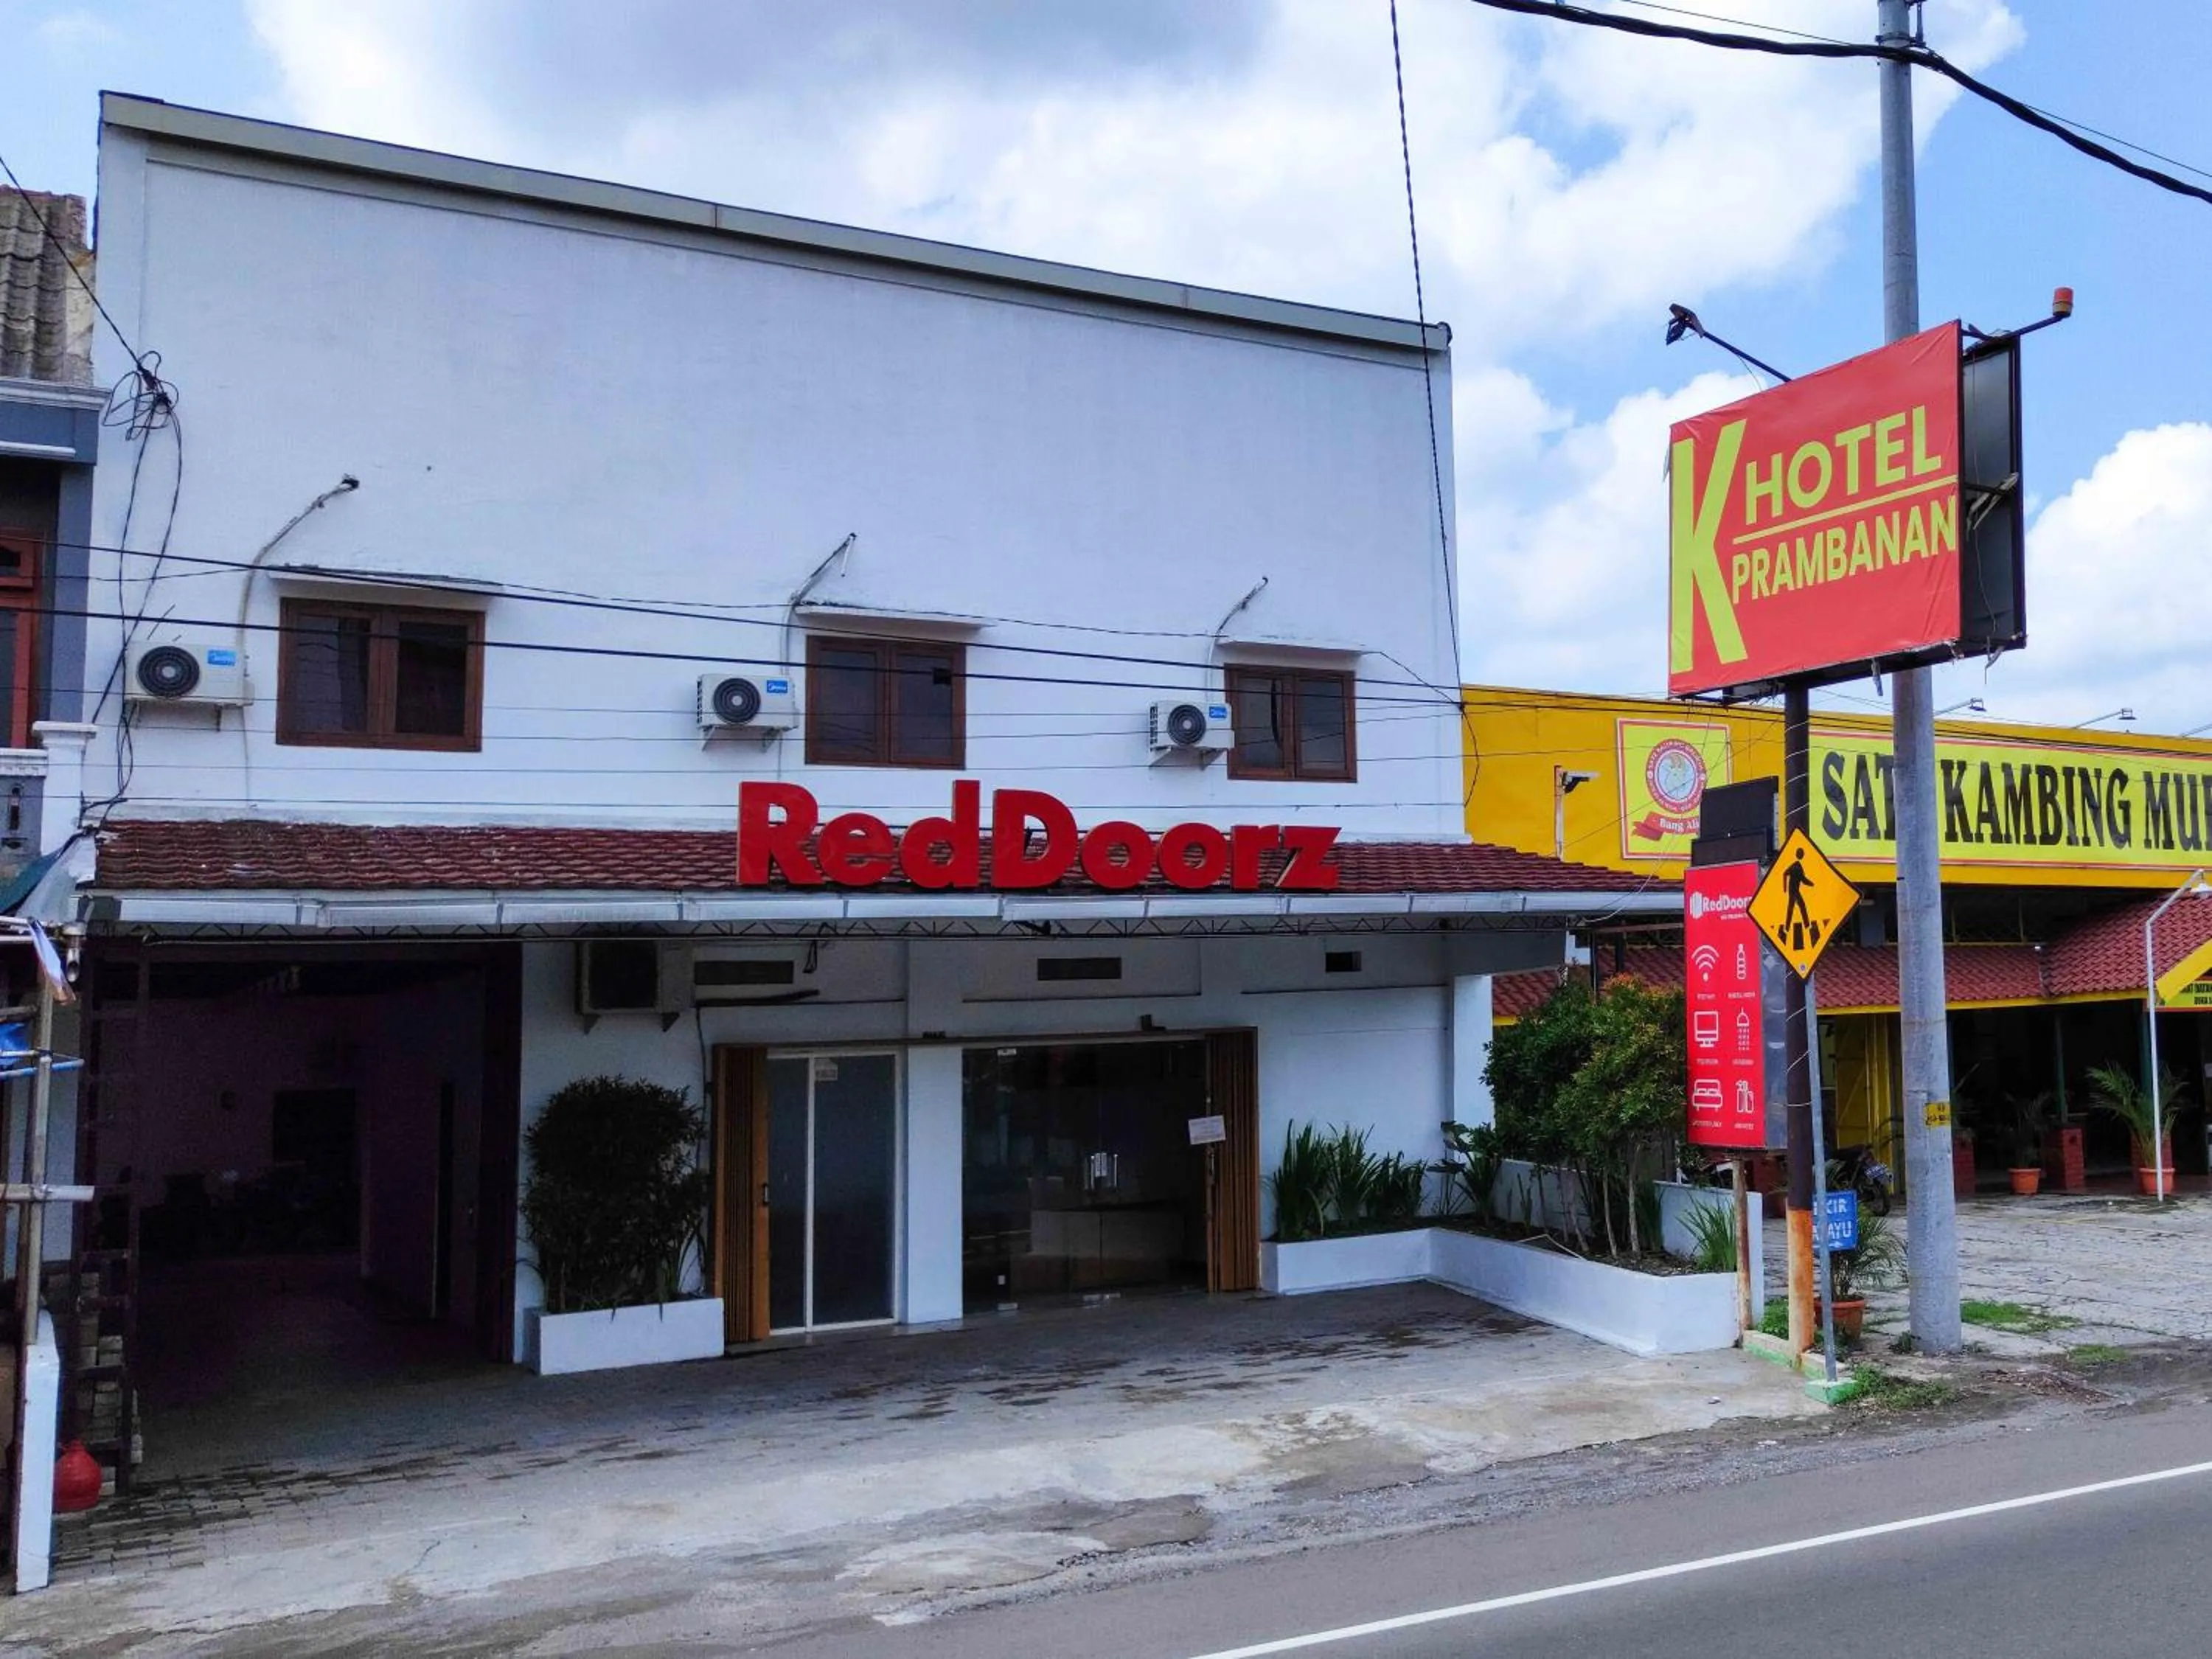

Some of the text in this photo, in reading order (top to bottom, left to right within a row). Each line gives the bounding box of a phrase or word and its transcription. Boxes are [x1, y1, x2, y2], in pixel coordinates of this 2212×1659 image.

[1745, 405, 1941, 525] HOTEL
[1670, 418, 1748, 674] K
[1731, 495, 1957, 605] PRAMBANAN
[738, 779, 1342, 891] RedDoorz
[1822, 751, 1897, 841] SAT
[1940, 759, 2132, 849] KAMBING
